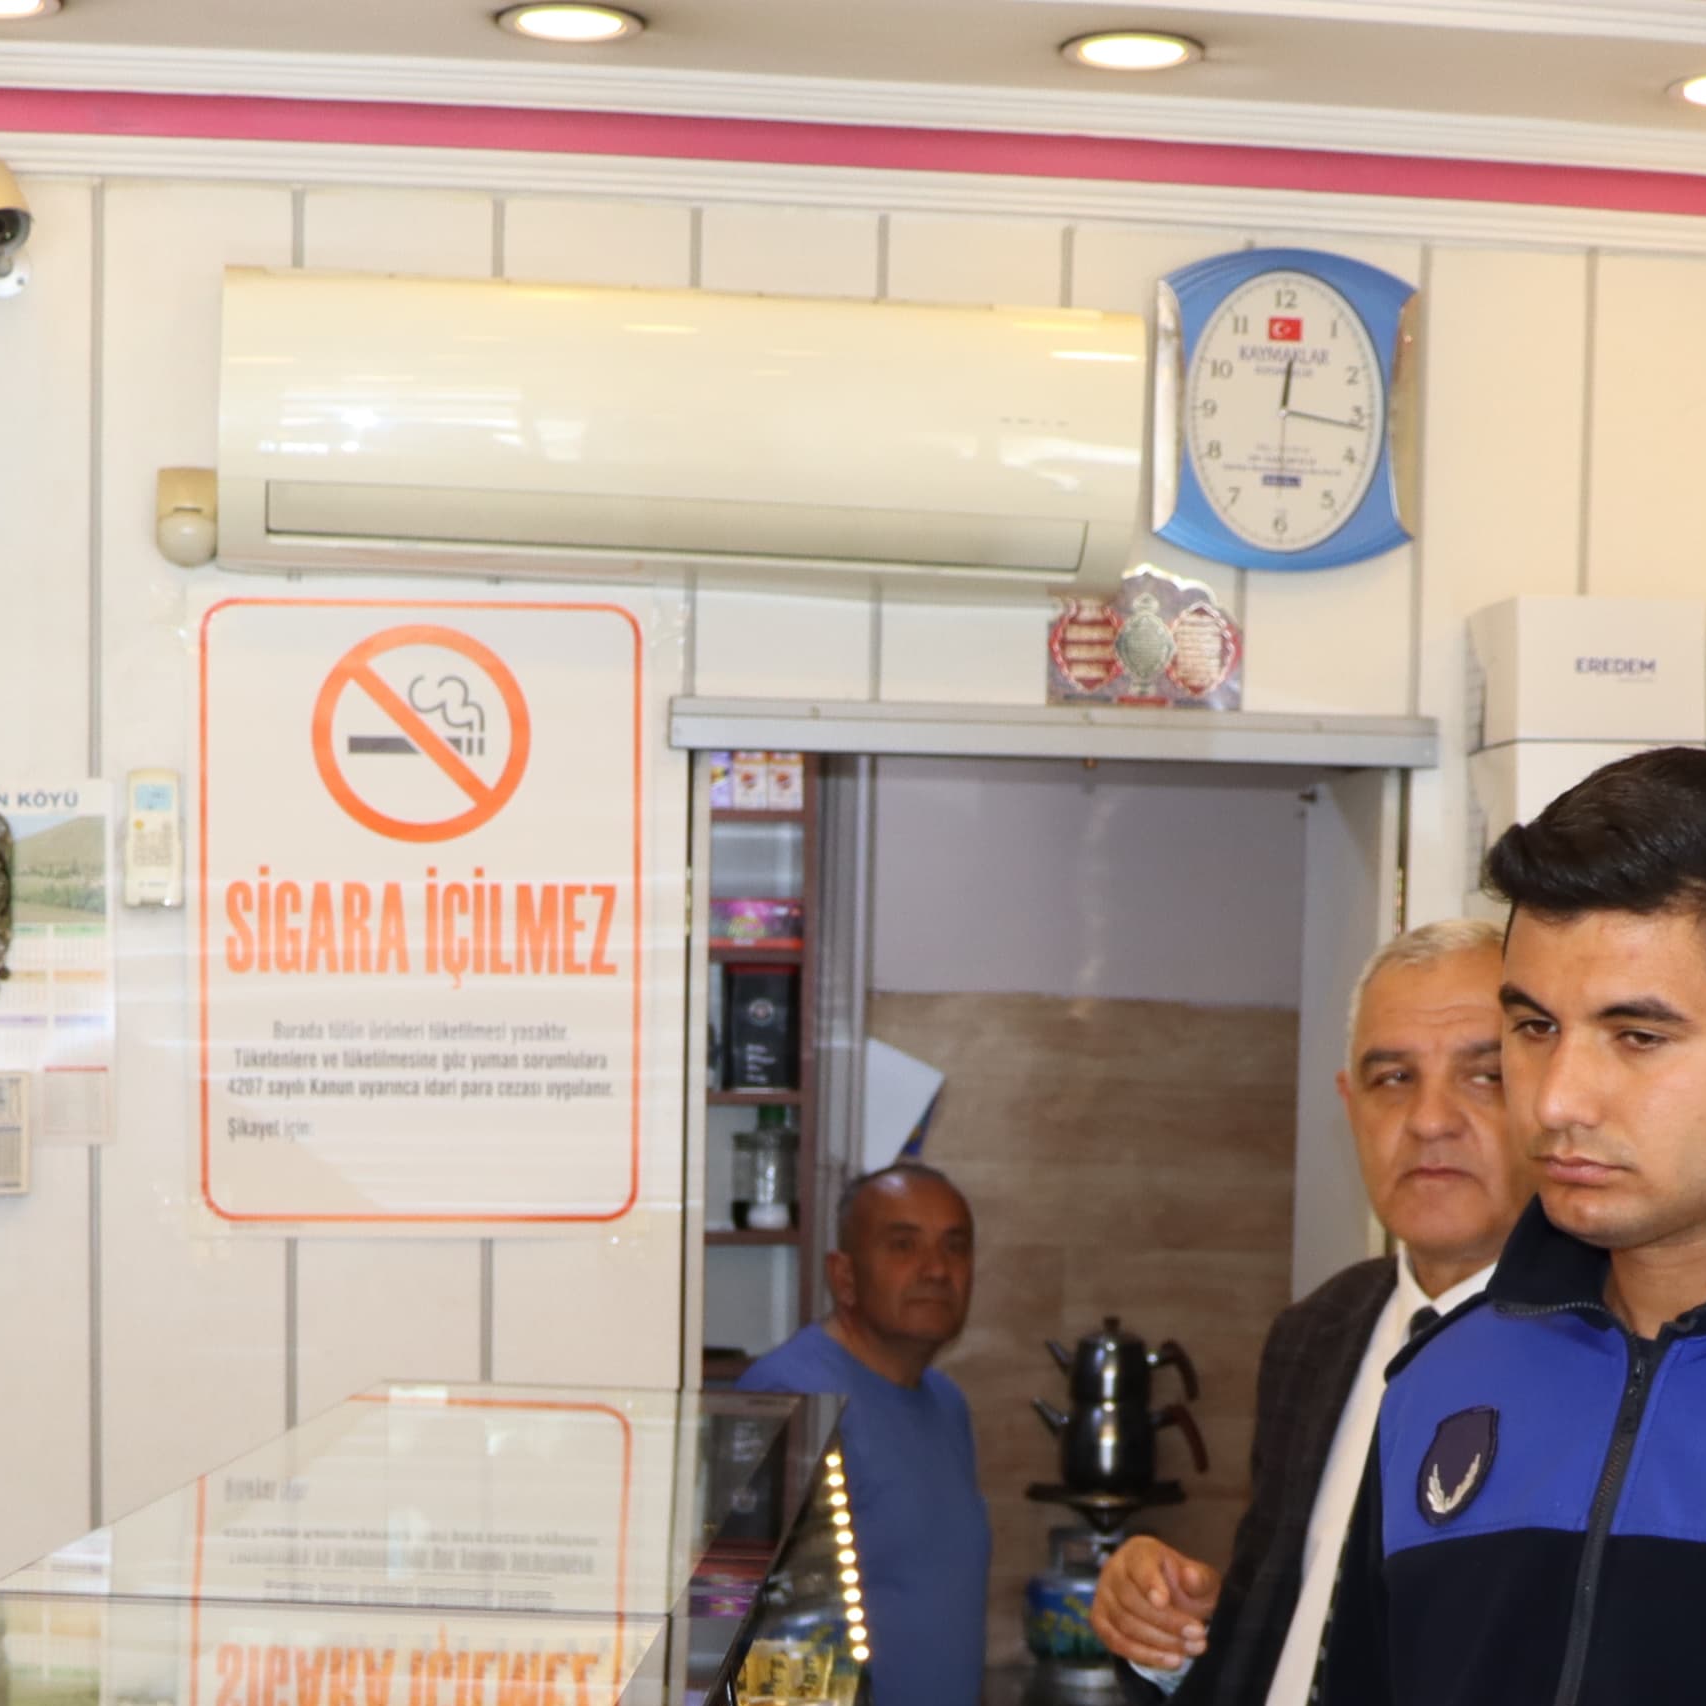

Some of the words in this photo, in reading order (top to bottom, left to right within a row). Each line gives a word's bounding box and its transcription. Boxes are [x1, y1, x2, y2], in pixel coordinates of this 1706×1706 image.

[1274, 289, 1298, 310] 12
[1232, 315, 1249, 335] 11
[1209, 359, 1234, 379] 10
[1346, 365, 1360, 386] 2
[1201, 397, 1218, 418] 9
[1206, 439, 1223, 460] 8
[1342, 447, 1357, 465] 4
[1227, 486, 1242, 506] 7
[1320, 488, 1337, 510] 5
[1271, 513, 1289, 535] 6
[1575, 657, 1657, 677] EREDEM
[16, 789, 80, 809] KÖYÜ
[225, 865, 410, 974] SİGARA
[425, 867, 618, 989] İÇİLMEZ
[273, 1020, 323, 1040] Burada
[328, 1021, 365, 1041] tütün
[369, 1021, 425, 1041] ürünleri
[429, 1021, 507, 1041] tüketilmesi
[234, 1048, 318, 1069] Tüketenlere
[322, 1053, 338, 1069] ve
[343, 1049, 438, 1070] tüketilmesine
[442, 1052, 466, 1073] göz
[470, 1054, 519, 1073] yuman
[523, 1050, 608, 1070] sorumlulara
[227, 1075, 264, 1096] 4207
[267, 1077, 305, 1100] sayılı
[309, 1077, 355, 1096] Kanun
[358, 1078, 420, 1101] uyarınca
[424, 1078, 457, 1097] idari
[460, 1080, 494, 1100] para
[497, 1080, 542, 1097] cezası
[227, 1115, 279, 1143] Şikayet
